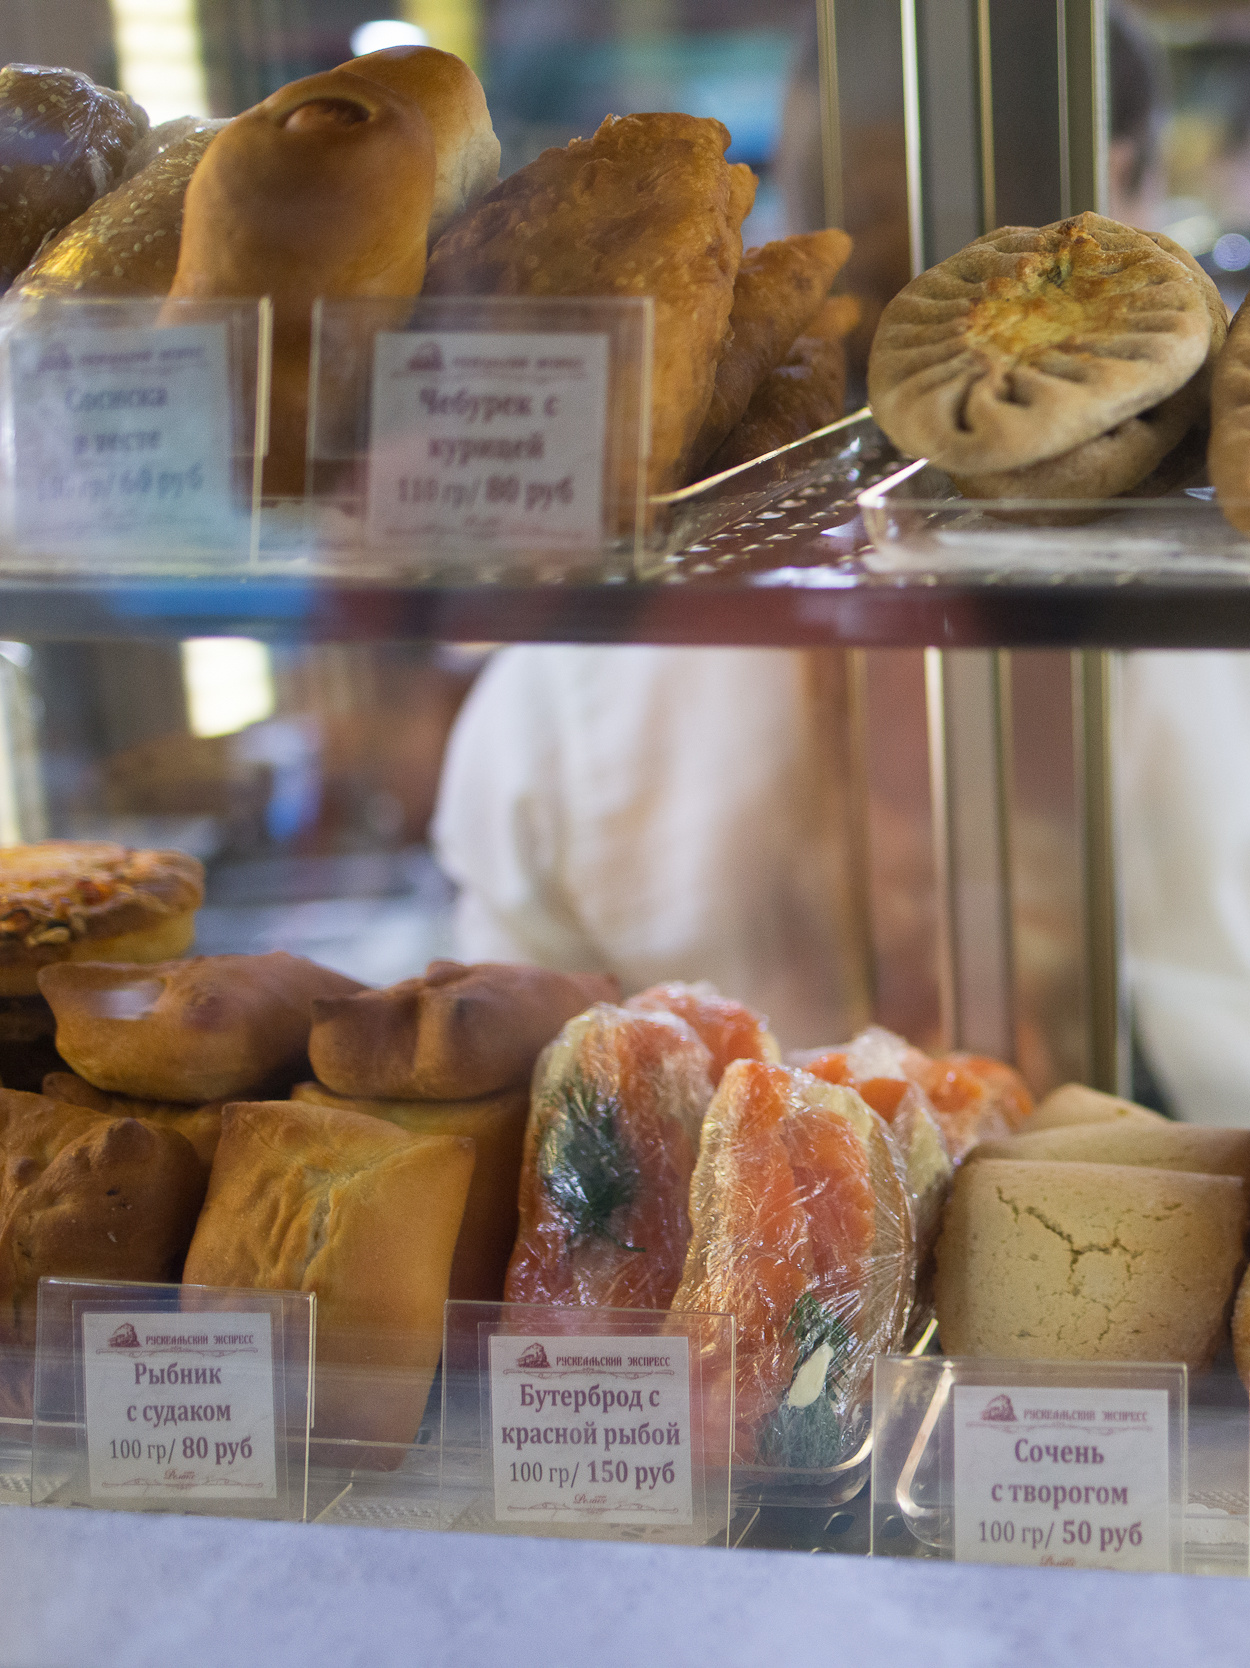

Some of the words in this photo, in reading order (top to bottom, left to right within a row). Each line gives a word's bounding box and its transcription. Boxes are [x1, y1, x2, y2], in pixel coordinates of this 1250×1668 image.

[419, 387, 533, 423] Чебурек
[543, 395, 557, 417] с
[428, 432, 544, 466] курицей
[157, 461, 204, 499] руб
[525, 475, 574, 511] руб
[213, 1334, 255, 1345] ЭКСПРЕСС
[134, 1362, 222, 1385] Рыбник
[556, 1355, 622, 1367] РУСКЕАЛЬСКИЙ
[627, 1356, 671, 1367] ЭКСПРЕСС
[520, 1383, 643, 1413] Бутерброд
[649, 1389, 660, 1407] с
[127, 1405, 137, 1422] с
[142, 1404, 231, 1428] судаком
[1101, 1410, 1148, 1422] ЭКСПРЕСС
[501, 1421, 598, 1450] красной
[604, 1422, 681, 1450] рыбой
[109, 1439, 142, 1459] 100
[147, 1438, 176, 1465] гр/
[182, 1436, 209, 1459] 80
[215, 1436, 253, 1465] руб
[1014, 1438, 1105, 1464] Сочень
[509, 1461, 543, 1482] 100
[549, 1462, 580, 1488] гр/
[587, 1460, 629, 1483] 150
[635, 1460, 675, 1490] руб
[991, 1484, 1003, 1502] с
[1008, 1485, 1128, 1511] творогом
[979, 1520, 1015, 1543] 100
[1022, 1521, 1055, 1549] гр/
[1062, 1519, 1092, 1544] 50
[1100, 1521, 1143, 1552] руб
